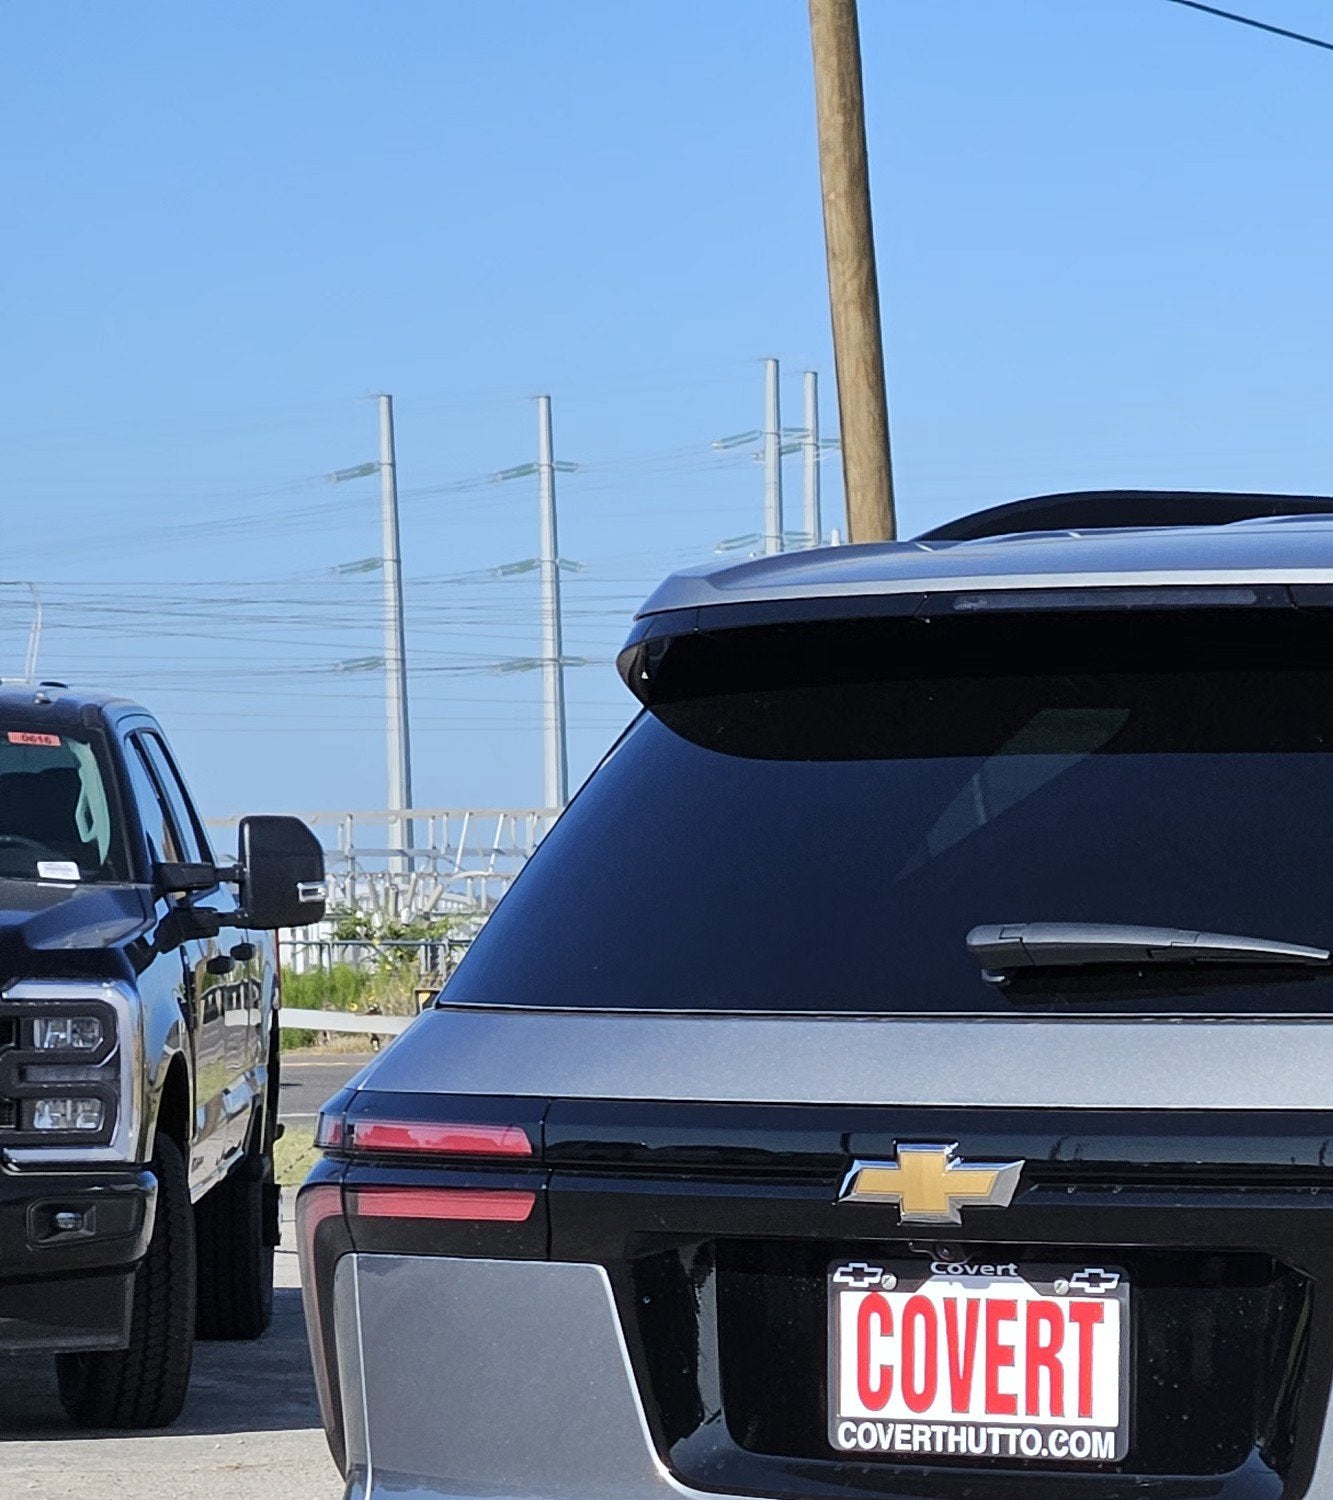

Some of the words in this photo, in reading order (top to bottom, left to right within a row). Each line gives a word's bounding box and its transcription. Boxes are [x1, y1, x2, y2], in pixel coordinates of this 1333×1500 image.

[930, 1261, 1018, 1277] Covert
[857, 1291, 1104, 1418] COVERT
[837, 1421, 1115, 1459] COVERTHUTTO.COM
